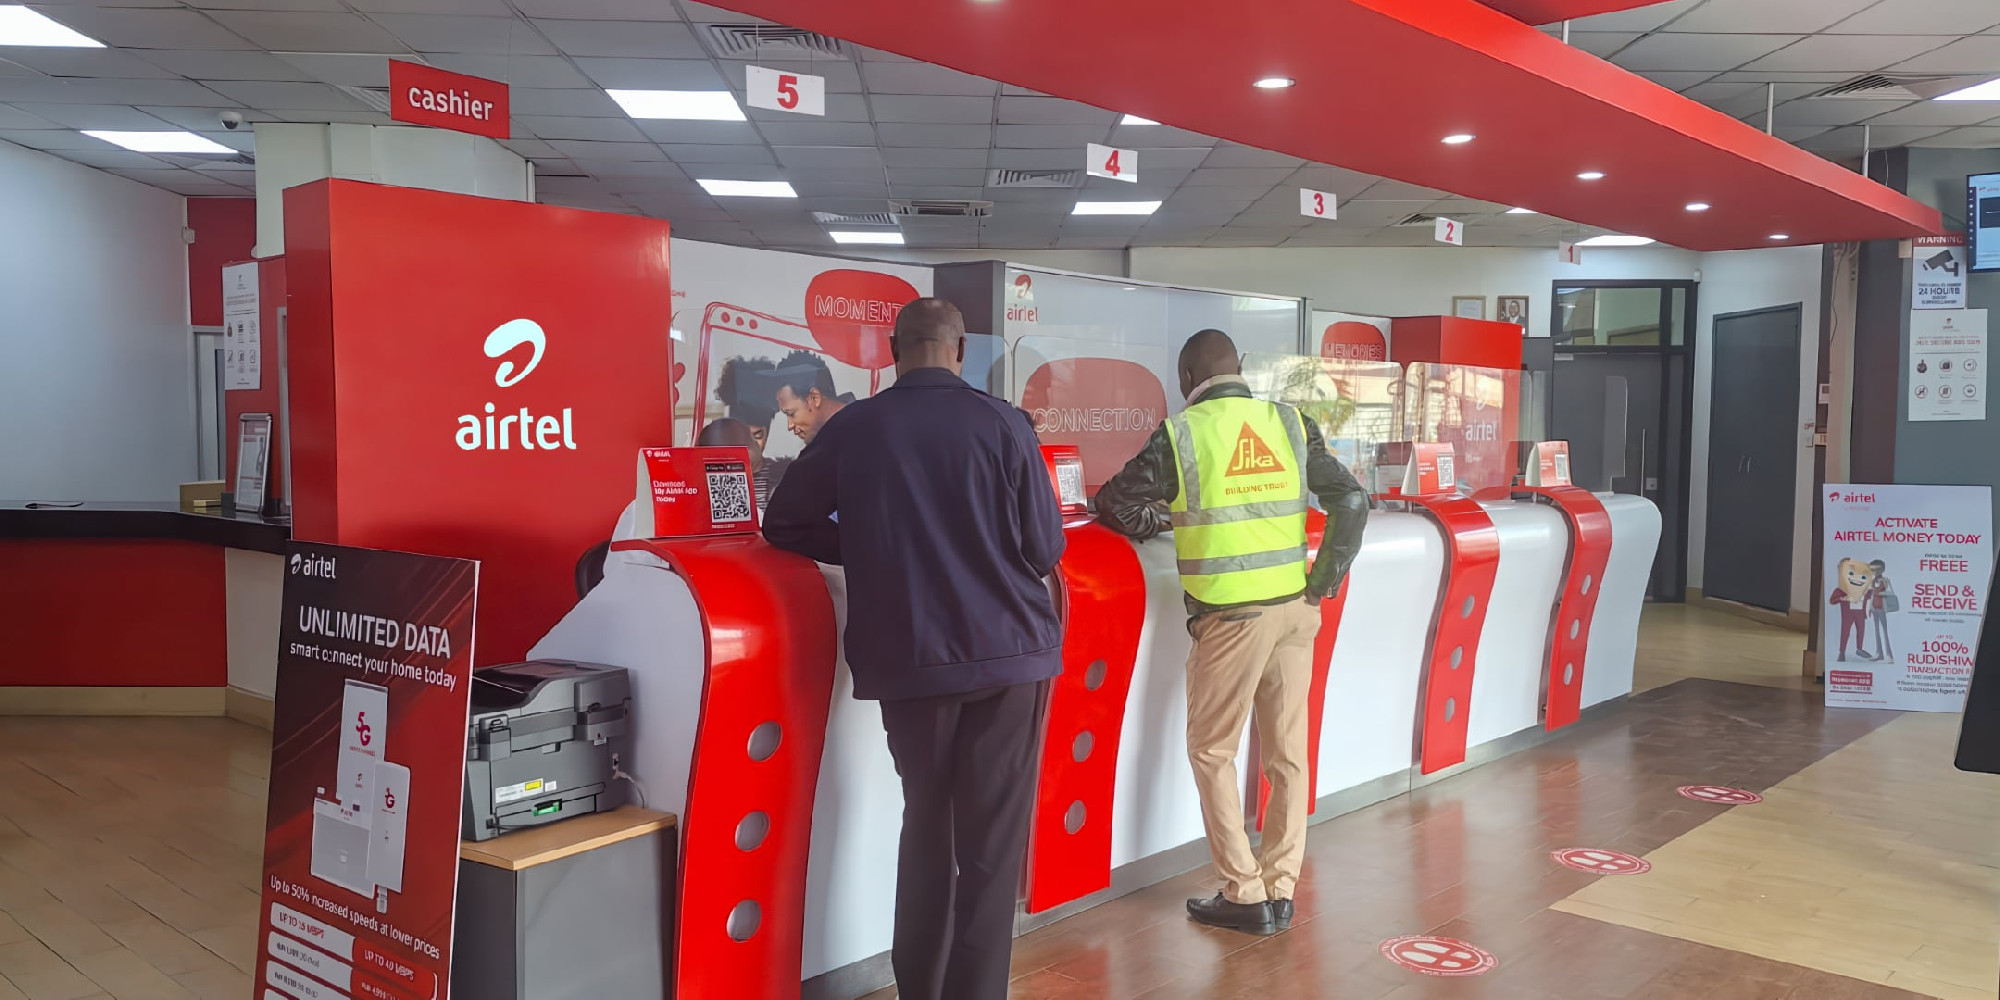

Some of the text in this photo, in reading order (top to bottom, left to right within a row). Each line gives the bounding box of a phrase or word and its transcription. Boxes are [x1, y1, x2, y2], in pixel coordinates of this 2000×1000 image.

[408, 87, 493, 121] cashier
[777, 75, 799, 110] 5
[1104, 150, 1121, 177] 4
[1313, 192, 1325, 216] 3
[1445, 221, 1455, 242] 2
[1568, 244, 1574, 263] 1
[1006, 304, 1038, 322] airtel
[455, 401, 577, 451] airtel
[1465, 419, 1497, 442] airtel
[1232, 437, 1275, 471] Sika
[1844, 492, 1875, 503] airtel
[1875, 517, 1938, 529] ACTIVATE
[1834, 531, 1982, 545] AIRTEL MONEY TODAY
[303, 552, 336, 579] airtel
[1920, 559, 1969, 573] FREEE
[1914, 583, 1975, 597] SEND &
[1911, 596, 1978, 611] RECEIVE
[300, 605, 451, 660] UNLIMITED DATA
[1922, 640, 1969, 654] 100%
[290, 641, 457, 693] smart connect your home today
[355, 711, 371, 746] 5G
[270, 874, 281, 893] Up
[282, 880, 290, 895] to
[349, 910, 379, 932] speeds
[380, 923, 389, 937] at
[389, 924, 413, 946] lower
[413, 938, 440, 960] prices
